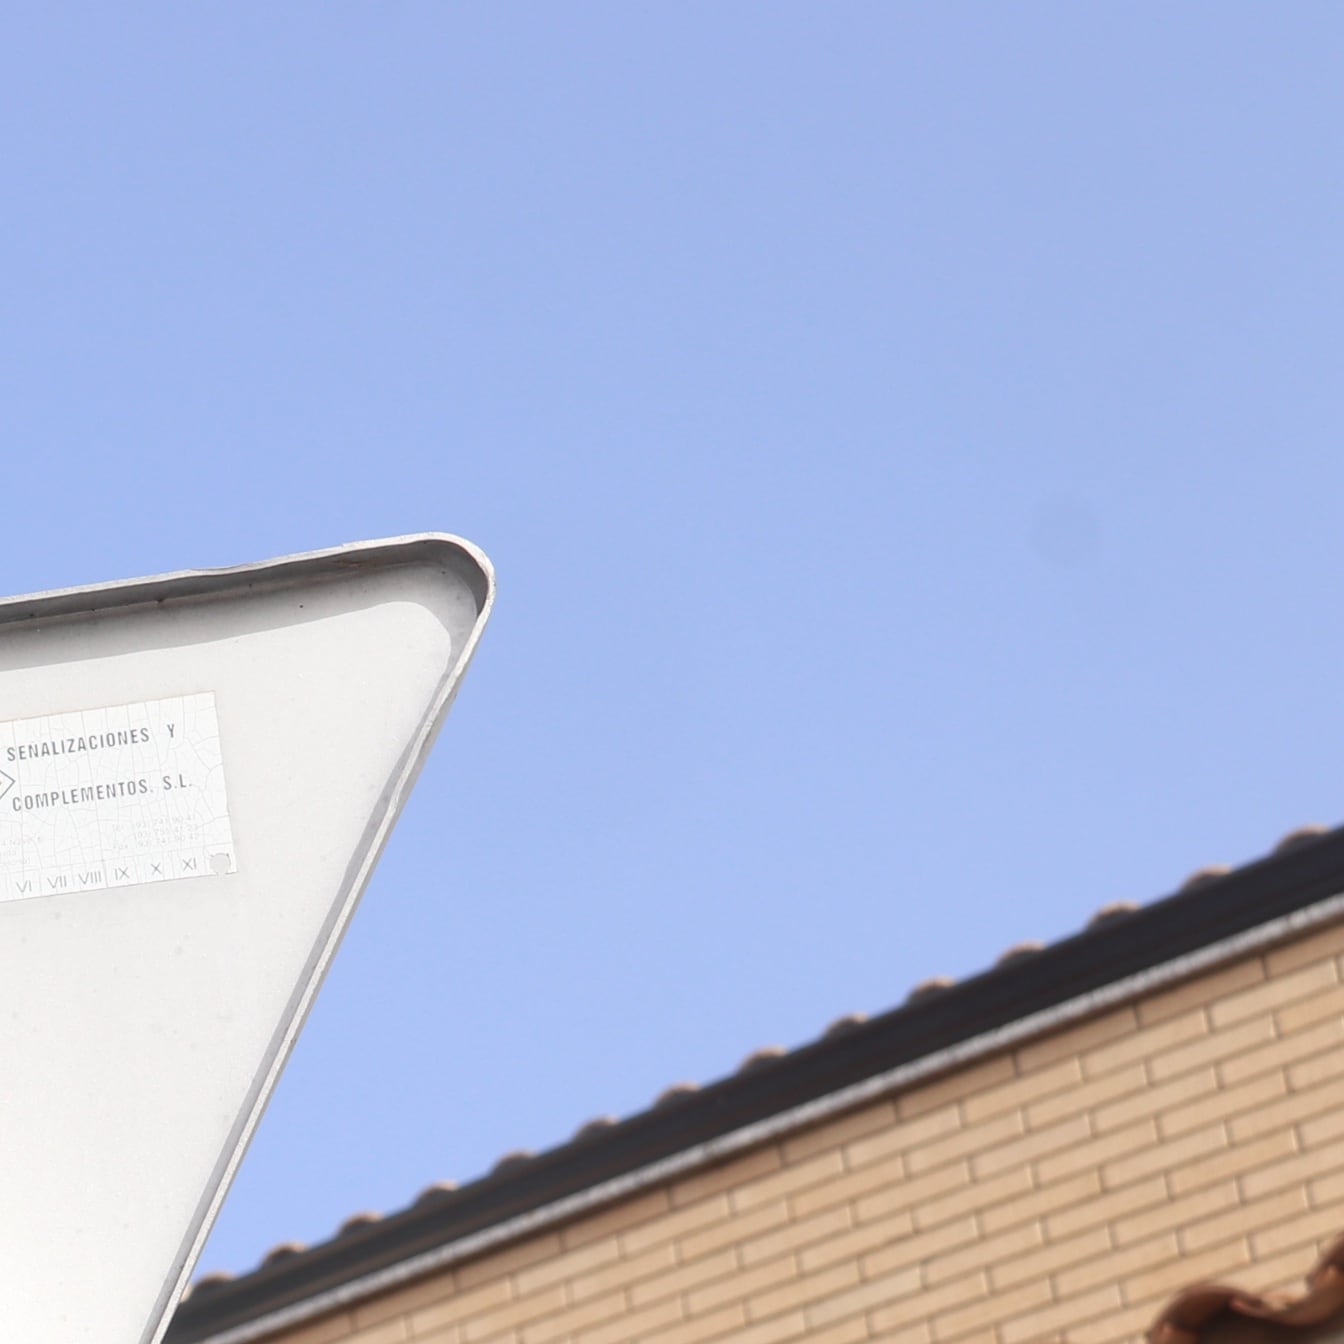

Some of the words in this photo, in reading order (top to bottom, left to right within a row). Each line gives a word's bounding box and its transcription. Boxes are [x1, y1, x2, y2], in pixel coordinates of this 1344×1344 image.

[166, 723, 176, 739] Y
[162, 773, 193, 791] S.L.
[16, 879, 32, 893] VI
[47, 875, 67, 889] VII
[78, 871, 102, 885] VIII
[114, 867, 130, 881] IX
[151, 862, 162, 875] X
[182, 857, 197, 870] XI
